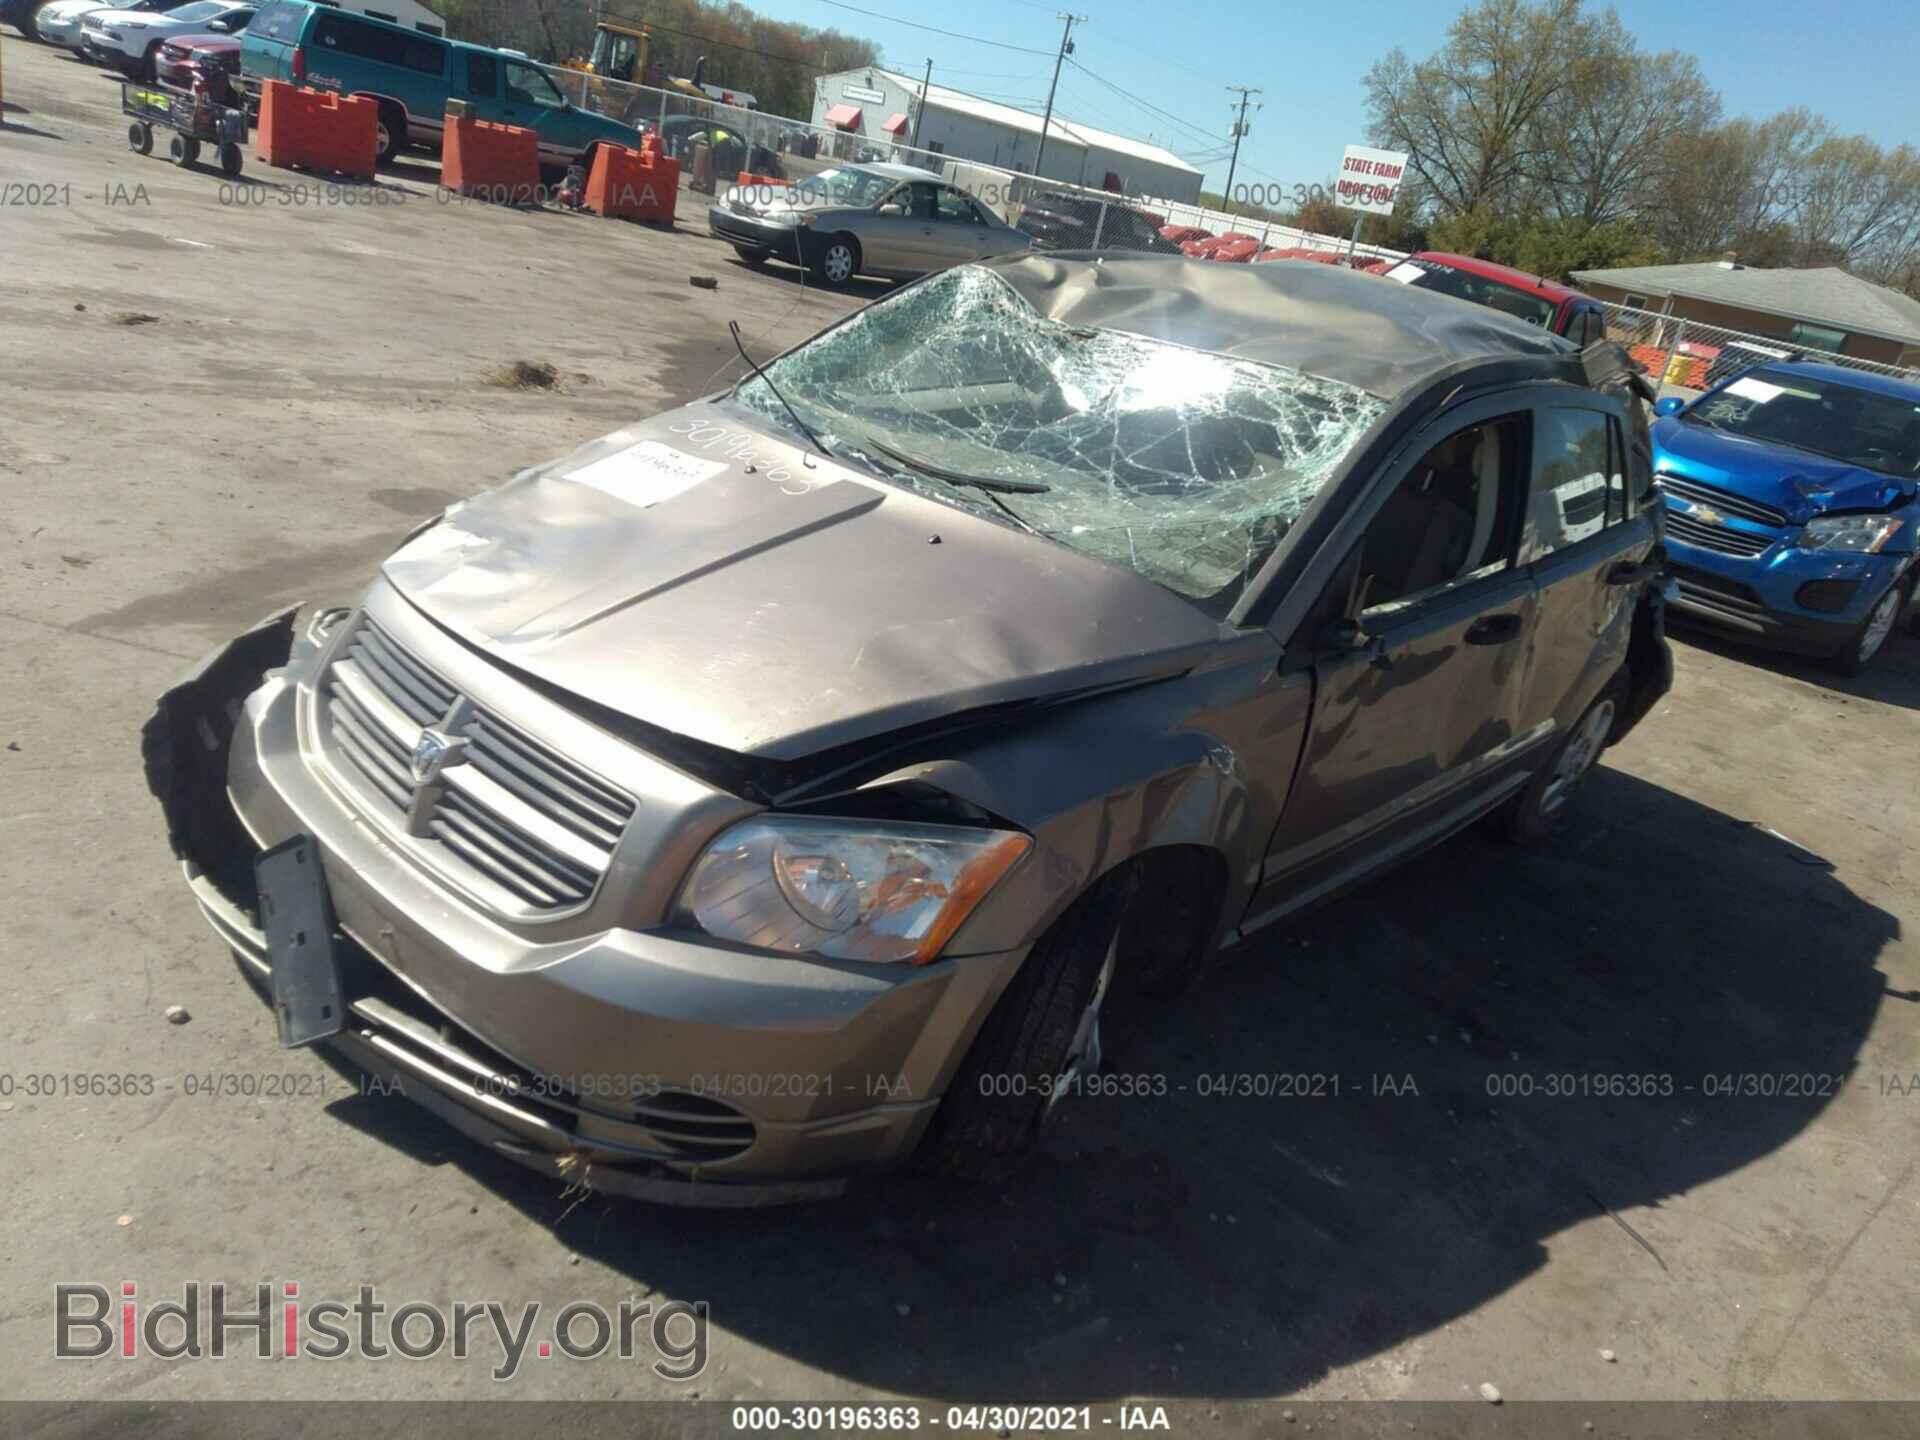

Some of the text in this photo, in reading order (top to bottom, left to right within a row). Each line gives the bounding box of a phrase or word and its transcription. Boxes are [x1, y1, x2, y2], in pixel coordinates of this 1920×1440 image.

[1344, 157, 1402, 178] STATE FARM
[1337, 179, 1366, 196] DROP
